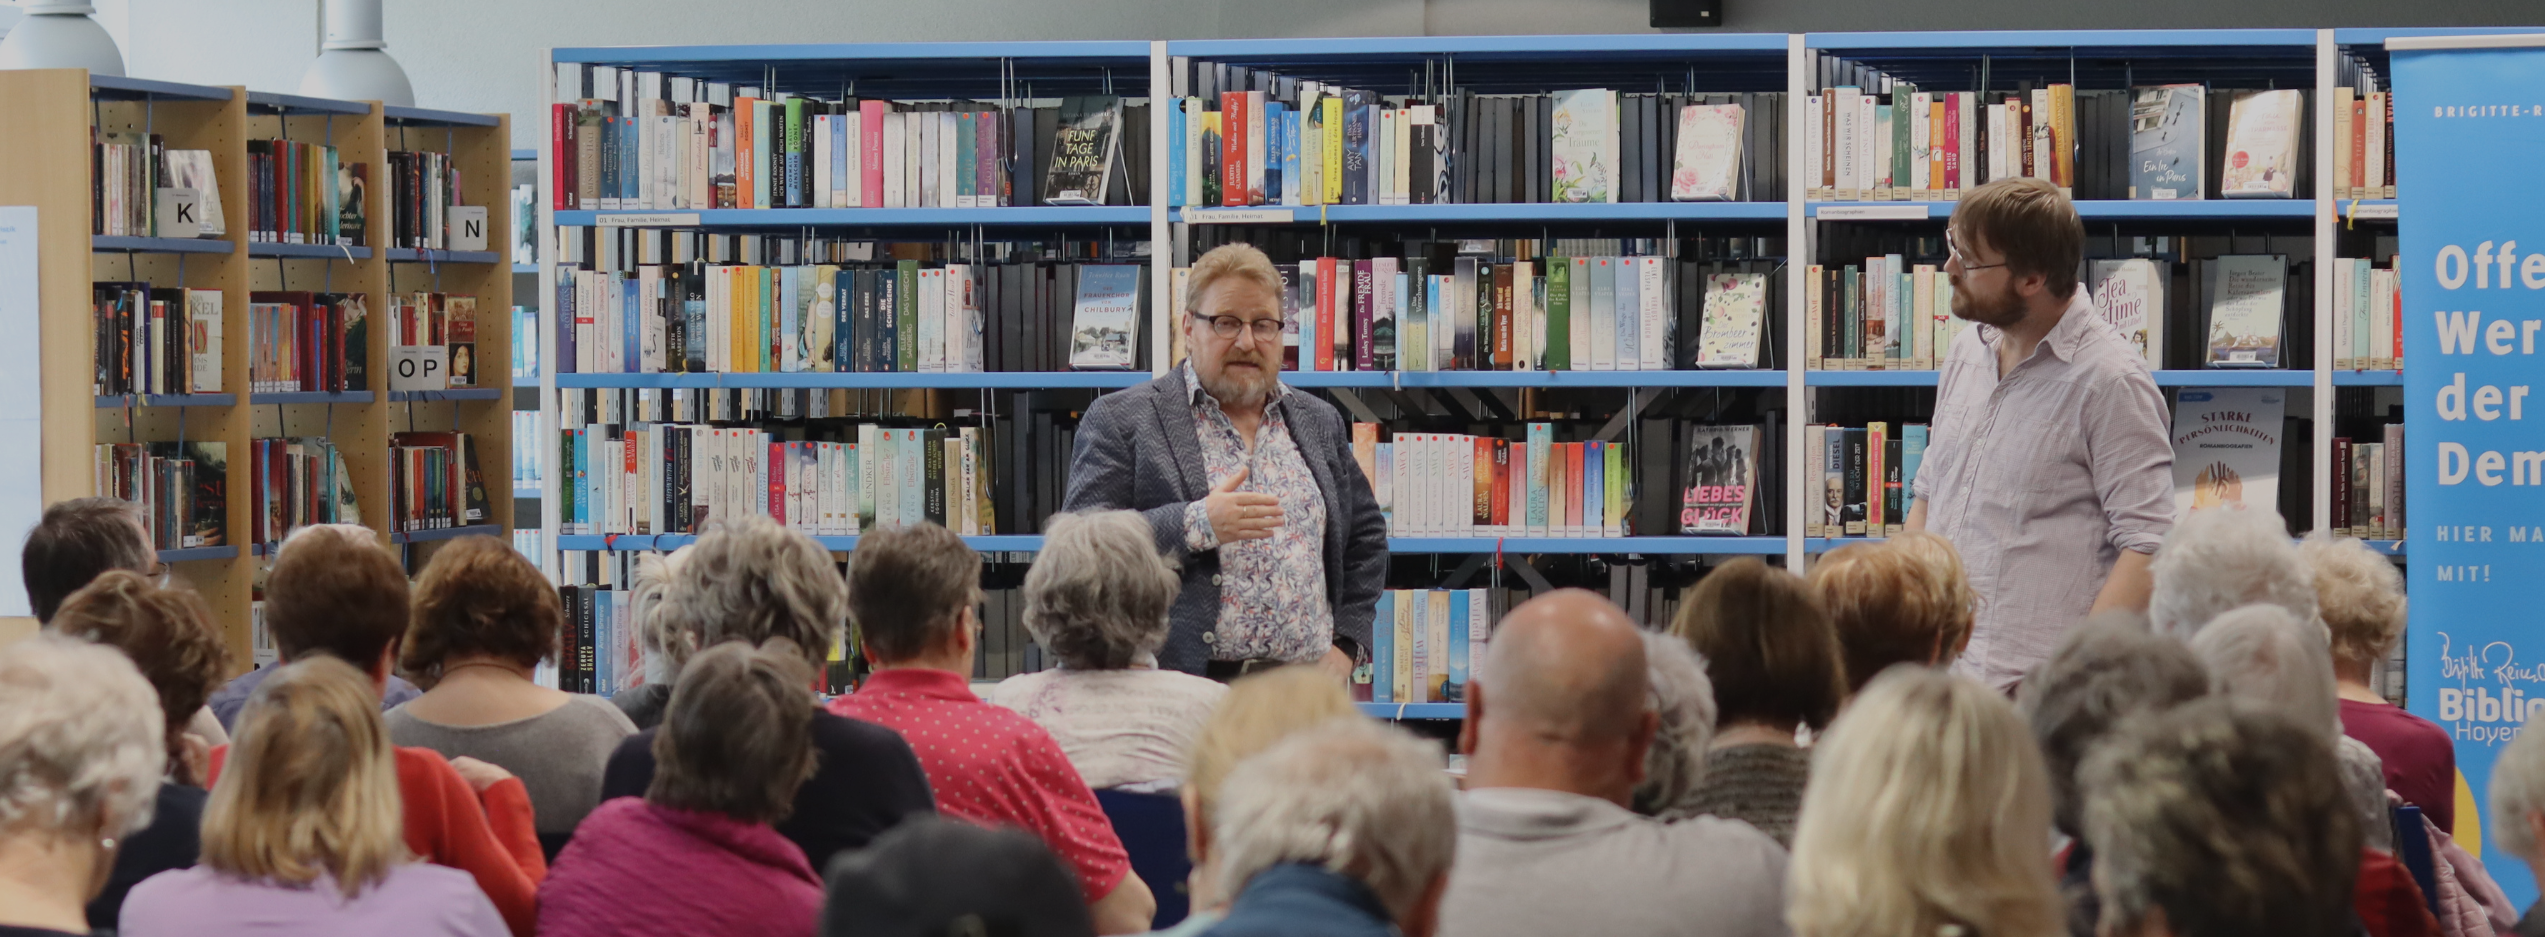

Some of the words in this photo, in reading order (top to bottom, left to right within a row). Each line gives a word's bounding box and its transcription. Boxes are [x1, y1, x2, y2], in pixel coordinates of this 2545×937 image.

[1231, 98, 1239, 120] Fluffy?
[2434, 104, 2542, 118] BRIGITTE-R
[587, 131, 595, 152] HALL
[1066, 143, 1093, 155] TAGE
[1568, 137, 1600, 147] Träume
[1055, 157, 1068, 168] IN
[1069, 155, 1099, 168] PARIS
[1354, 152, 1362, 171] TAN
[2143, 161, 2157, 173] Ein
[2158, 159, 2168, 172] Ire
[587, 154, 595, 196] ABINGDON
[2156, 173, 2165, 182] in
[2165, 170, 2187, 184] Paris
[177, 203, 194, 223] K
[611, 216, 626, 225] Frau,
[627, 216, 649, 224] Familie,
[1202, 213, 1217, 221] Frau,
[1218, 213, 1240, 221] Familie,
[465, 219, 480, 238] N
[2435, 240, 2545, 290] Offe
[1357, 270, 1365, 304] FREMDE
[1416, 265, 1424, 312] Verschwiegene
[2098, 274, 2126, 308] Tea
[1386, 291, 1394, 310] Frau
[2102, 297, 2142, 325] time
[2358, 300, 2367, 321] Frau
[1702, 326, 1747, 340] Brombeer
[1717, 321, 1728, 329] Das
[2434, 310, 2542, 356] Wer
[1723, 340, 1755, 350] zimmer
[398, 358, 416, 378] O
[423, 359, 438, 377] P
[2436, 372, 2529, 421] der
[2201, 410, 2253, 424] STARKE
[2179, 423, 2276, 446] PERSÖNLICHKEITEN
[1832, 438, 1840, 469] DIESEL
[2438, 442, 2545, 487] Dem
[865, 459, 873, 499] SENDKER
[1683, 485, 1746, 503] LIEBES
[2393, 480, 2401, 514] ROTH
[1681, 507, 1743, 525] GLÜCK
[2437, 525, 2493, 542] HIER
[2509, 526, 2545, 543] MA
[2437, 564, 2491, 582] MIT!
[1471, 597, 1480, 638] Willett
[1415, 640, 1424, 680] Willett
